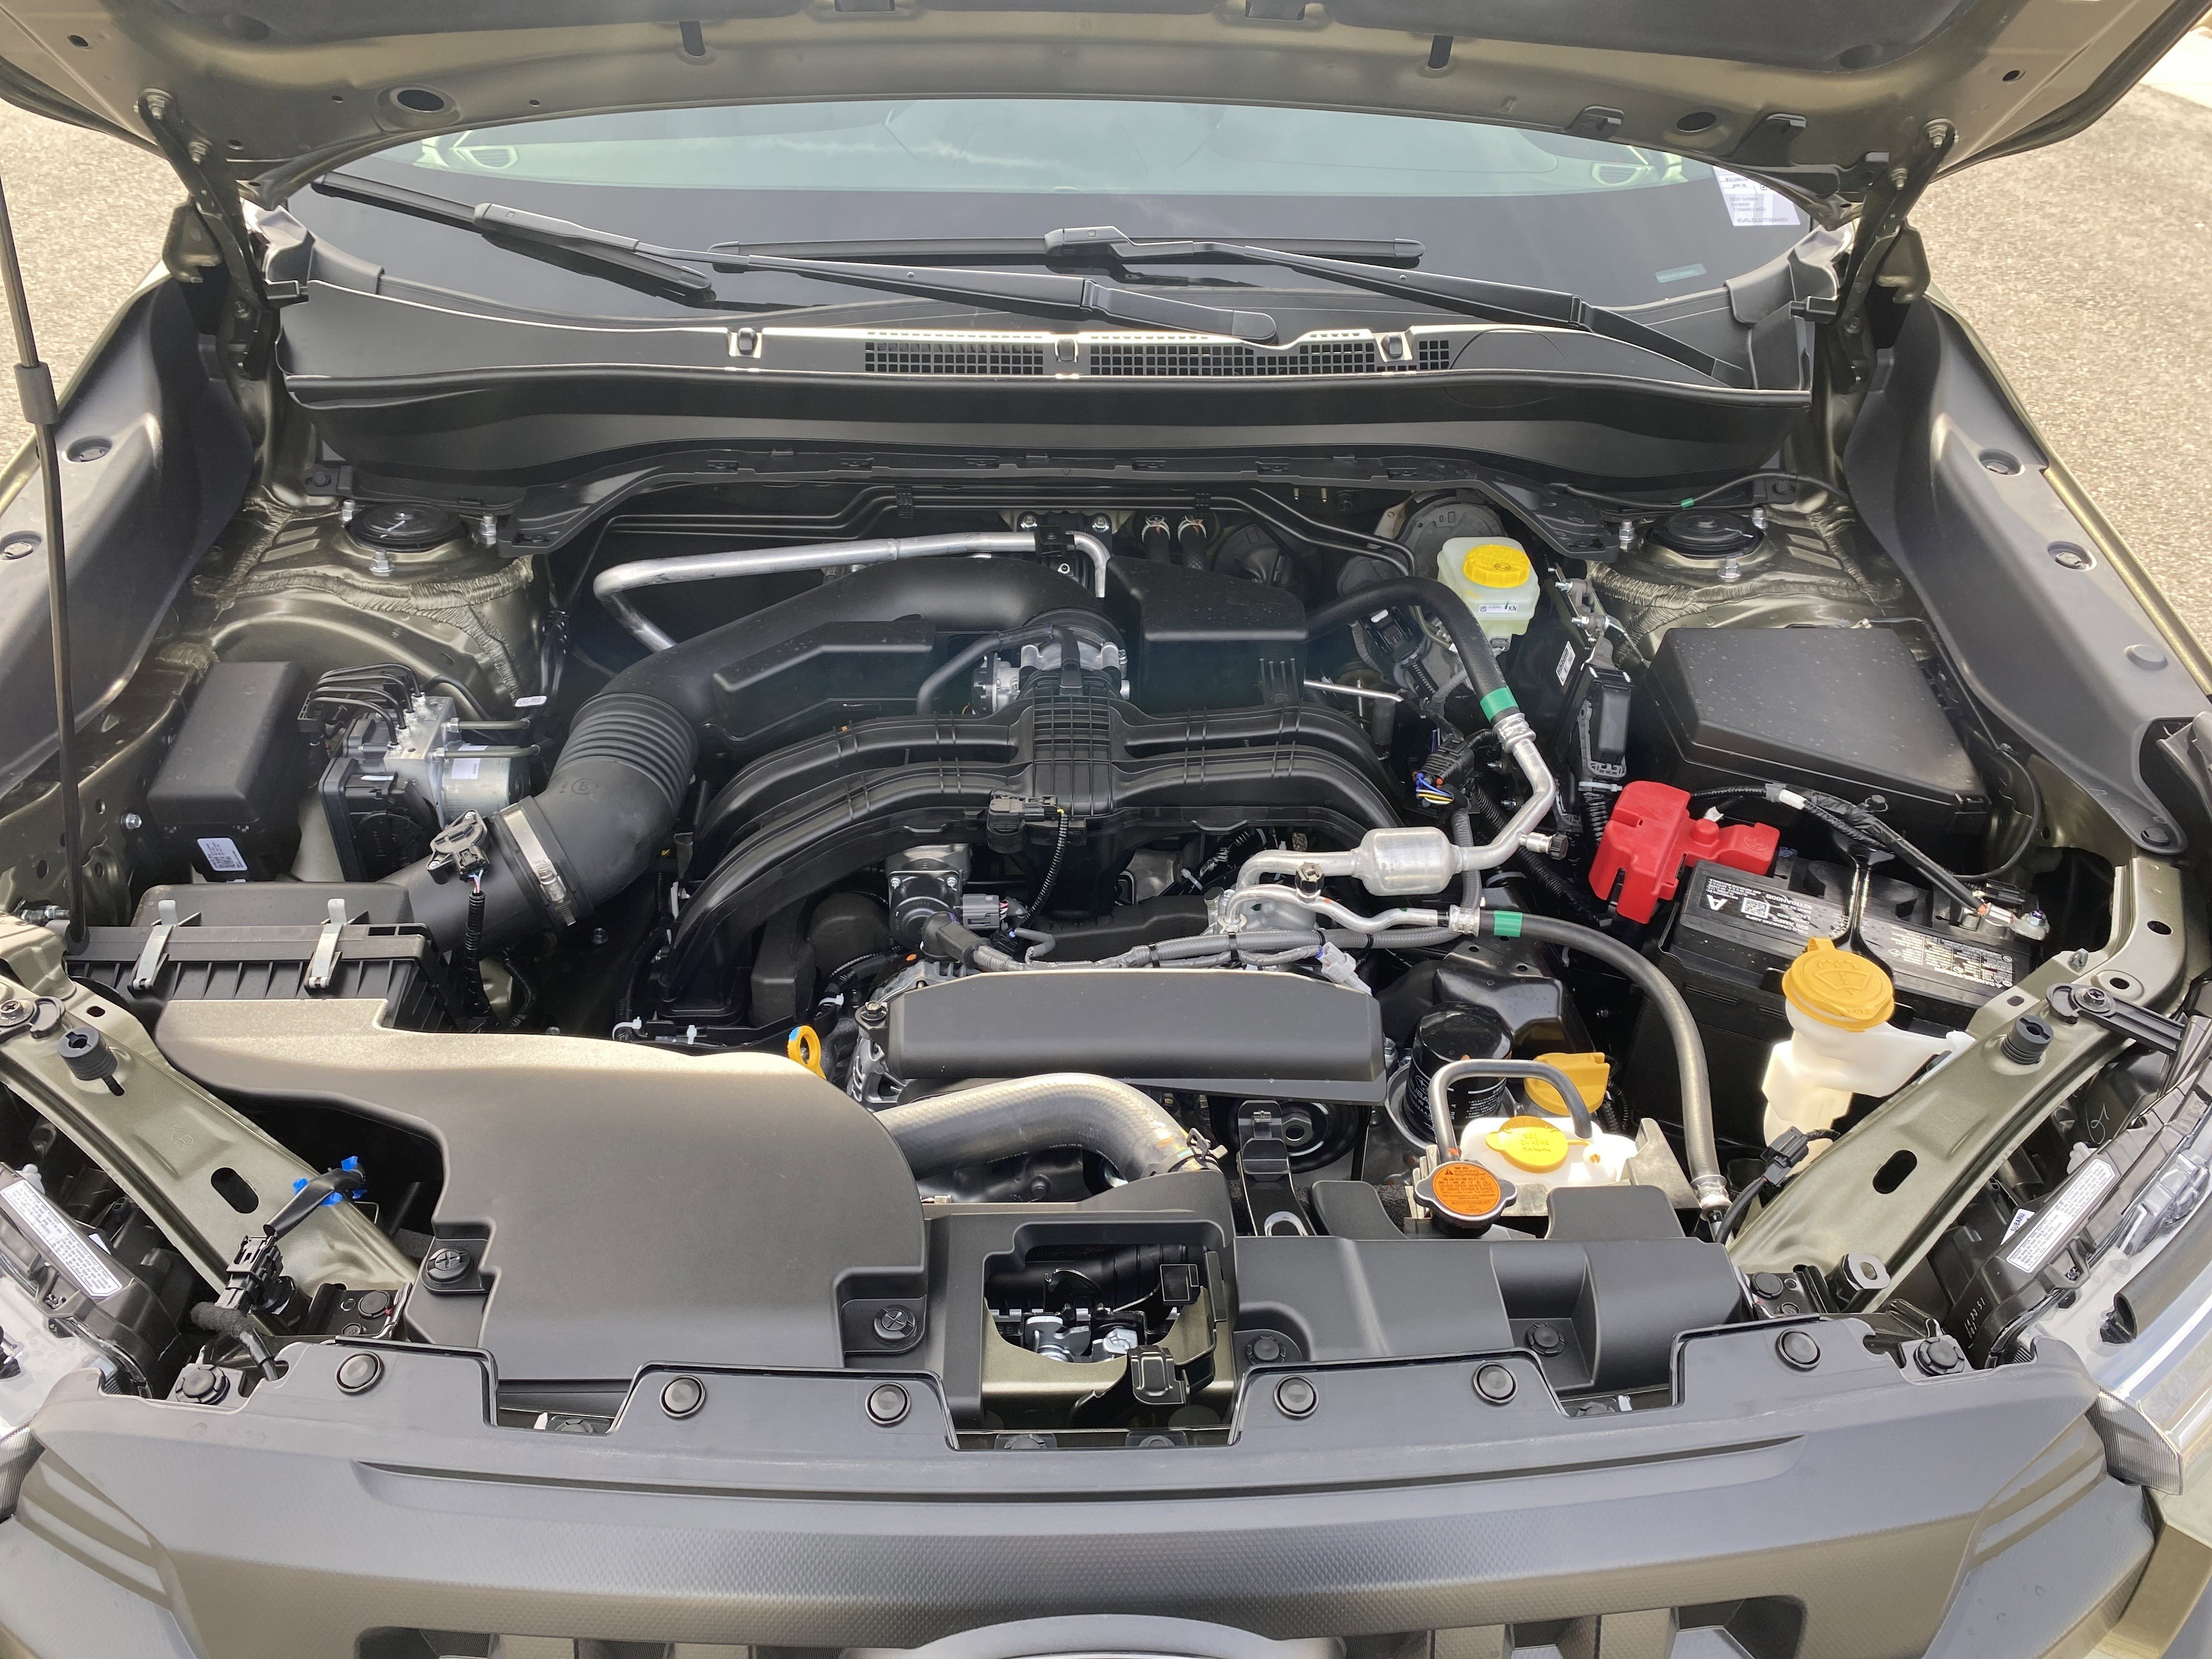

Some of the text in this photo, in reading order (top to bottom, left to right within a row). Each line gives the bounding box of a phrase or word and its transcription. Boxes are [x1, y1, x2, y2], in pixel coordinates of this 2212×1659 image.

[1707, 894, 1728, 911] A
[1762, 919, 1792, 930] CRANKING
[1773, 917, 1794, 926] AMPS
[1790, 916, 1810, 924] GROUP
[2010, 1212, 2025, 1232] SUBARU
